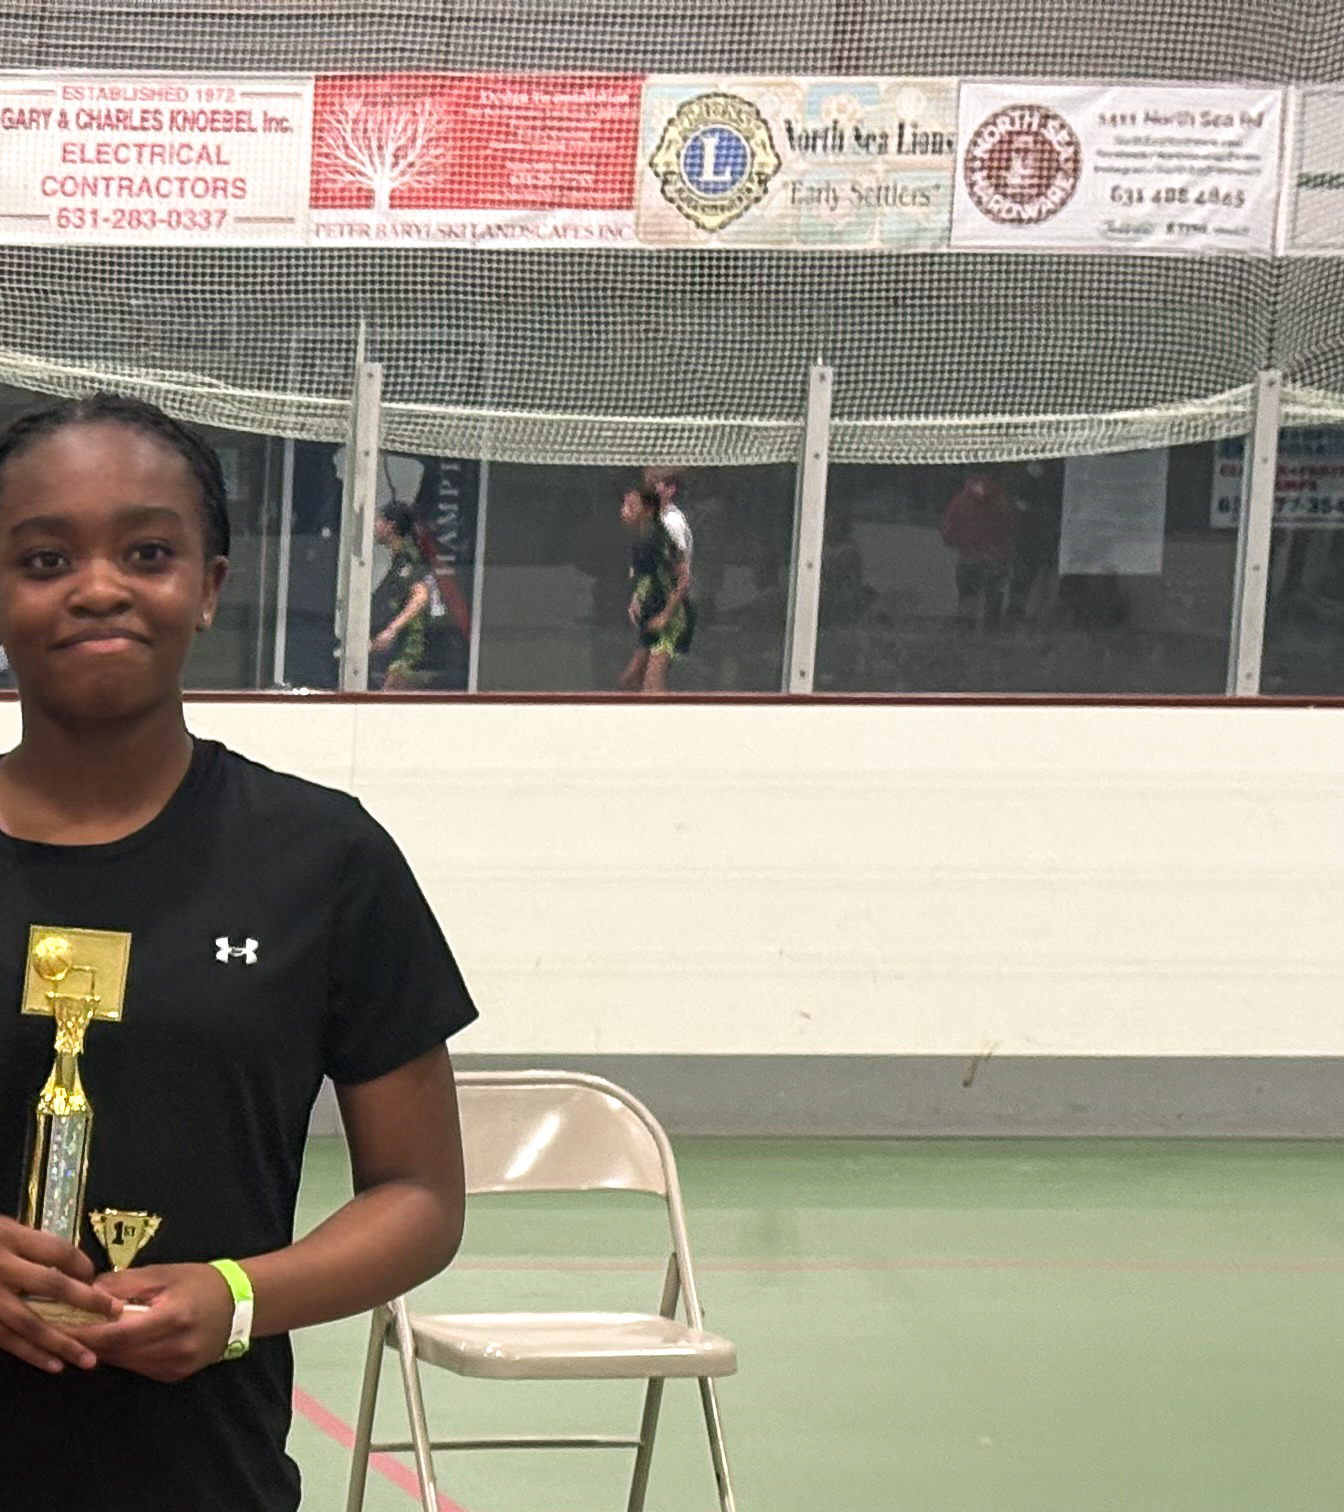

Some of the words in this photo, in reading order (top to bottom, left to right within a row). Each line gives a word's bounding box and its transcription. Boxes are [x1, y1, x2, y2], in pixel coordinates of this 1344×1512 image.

[61, 86, 189, 102] ESTABLISHED
[0, 107, 54, 131] GARY
[57, 109, 69, 130] &
[75, 109, 163, 132] CHARLES
[168, 109, 258, 133] KNOEBEL
[262, 110, 294, 133] Inc.
[1142, 110, 1196, 127] North
[1200, 111, 1234, 128] Sea
[784, 118, 846, 153] North
[853, 125, 890, 155] Sea
[896, 118, 955, 156] Lions
[973, 110, 1040, 159] NORTH
[61, 142, 231, 166] ELECTRICAL
[40, 175, 247, 200] CONTRACTORS
[56, 207, 229, 231] 631-283-0337
